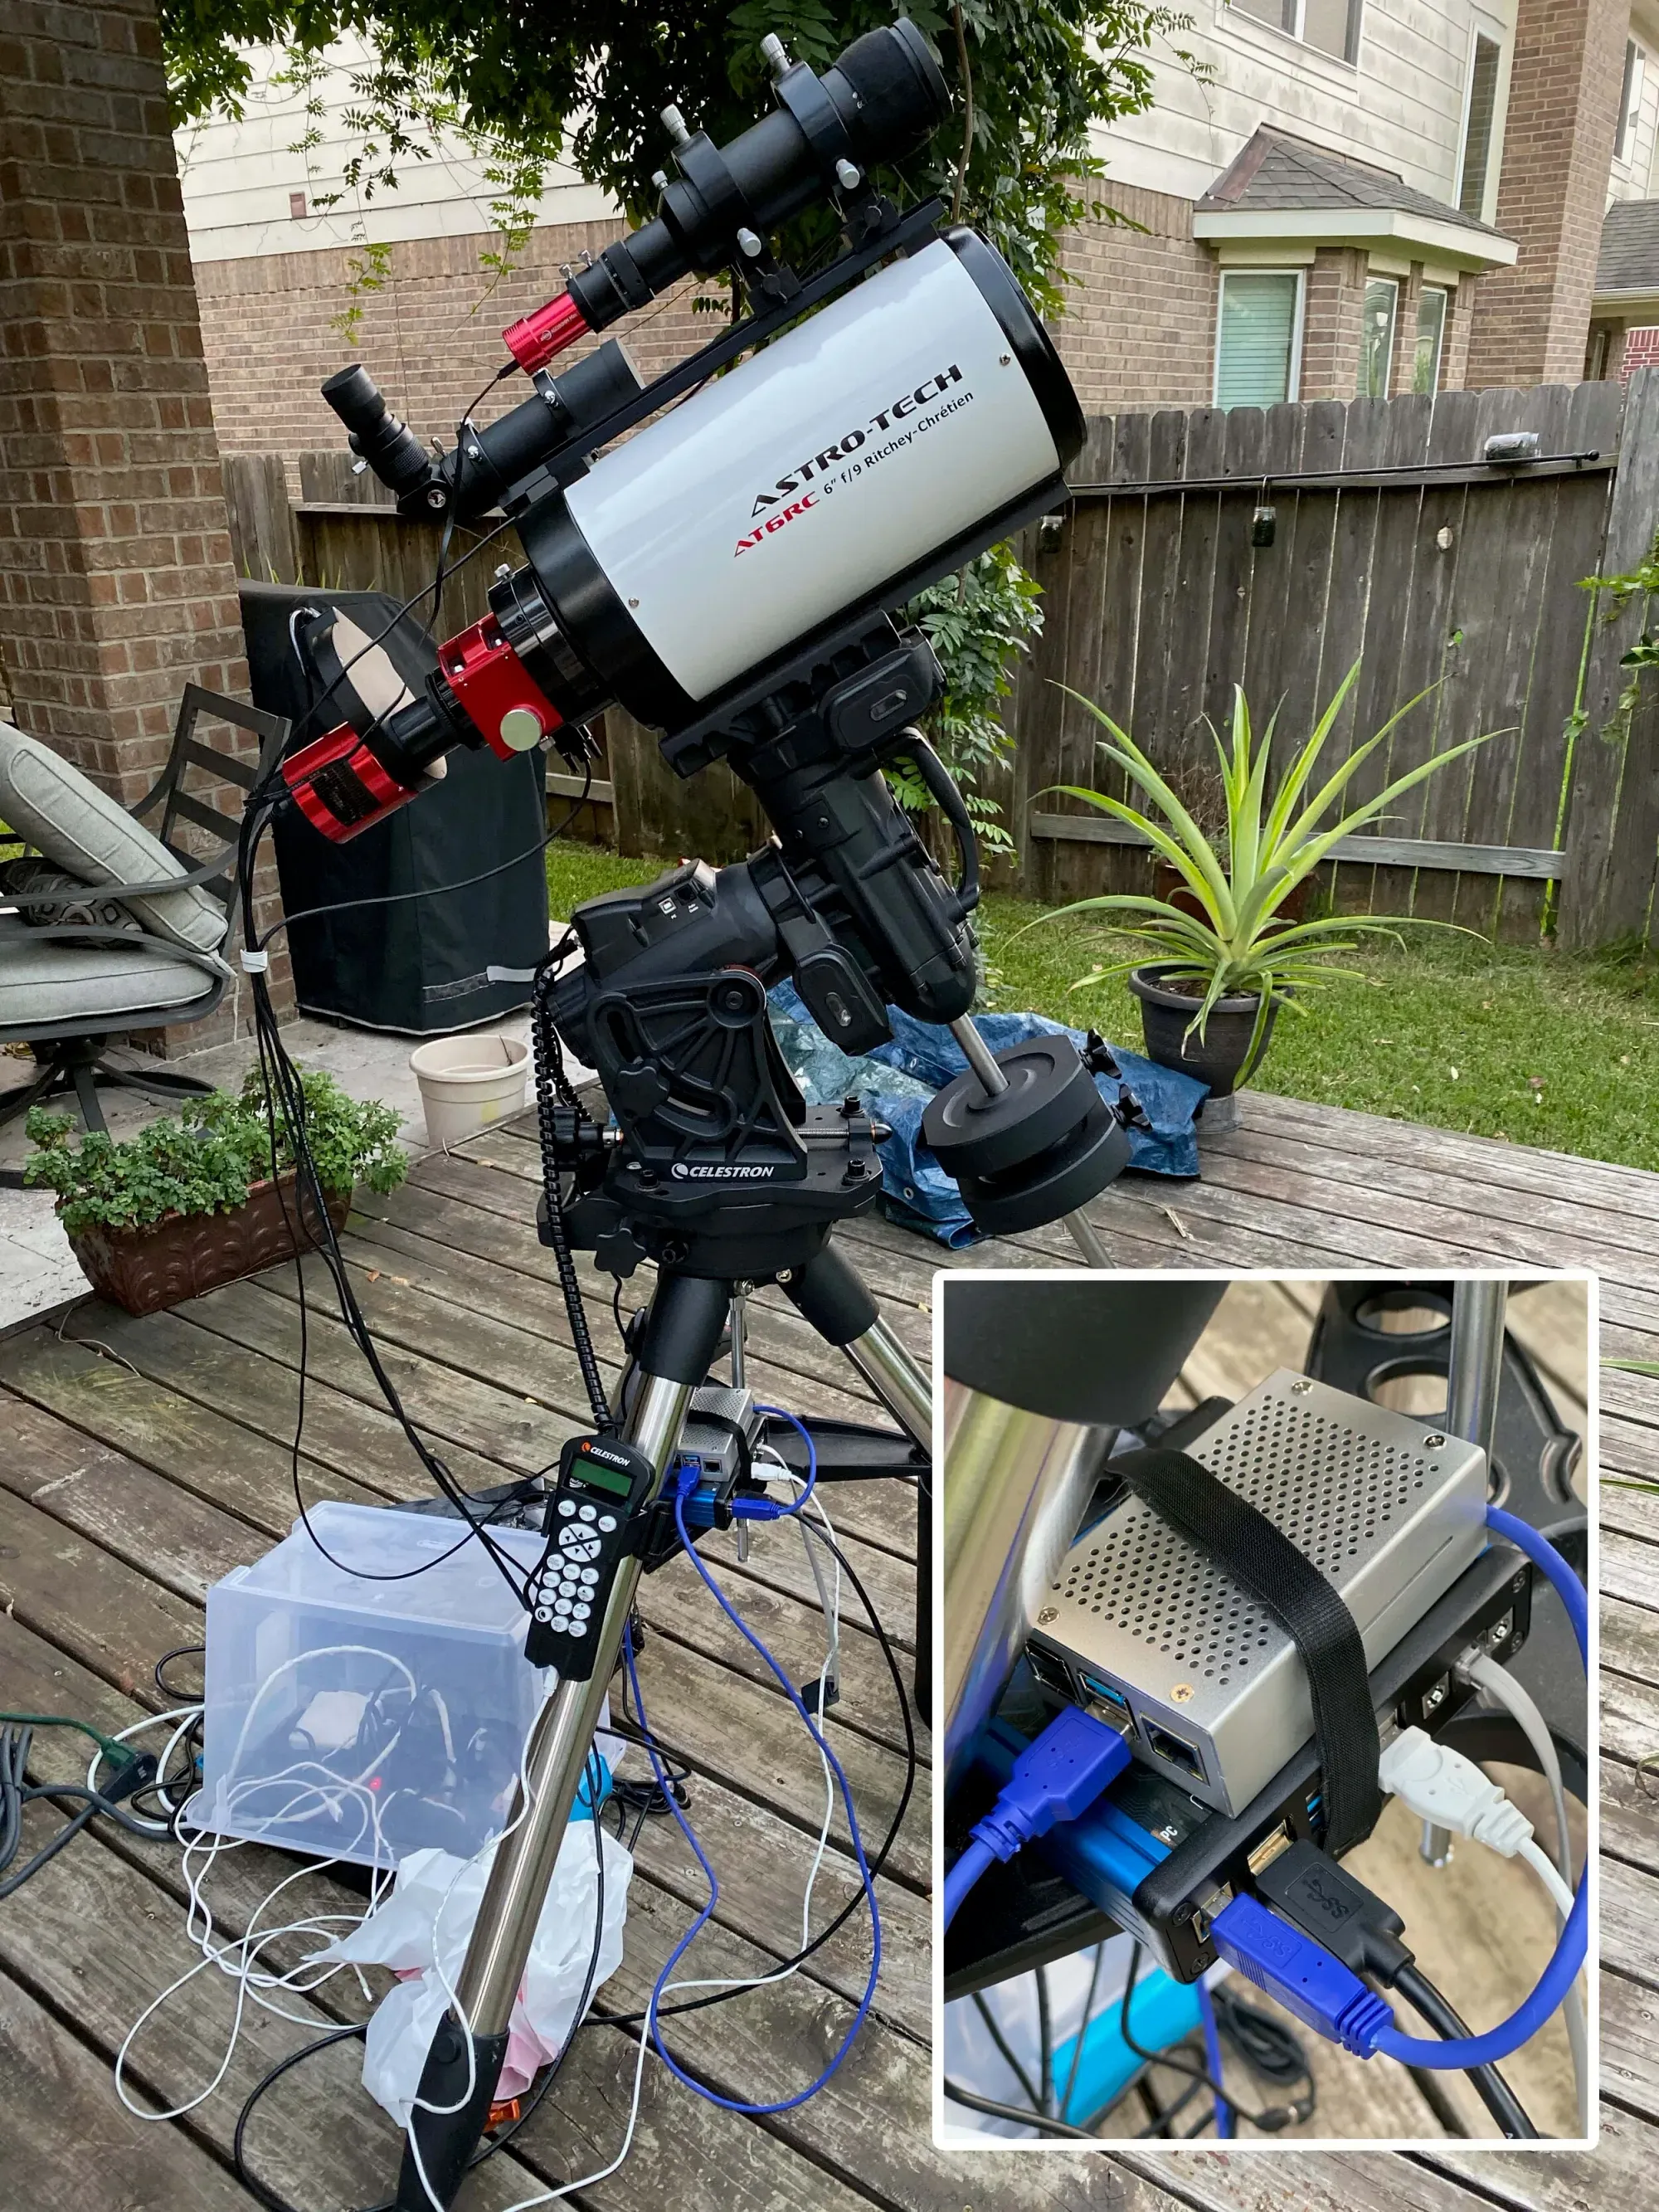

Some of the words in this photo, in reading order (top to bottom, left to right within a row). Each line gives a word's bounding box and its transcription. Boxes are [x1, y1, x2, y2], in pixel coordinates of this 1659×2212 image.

[752, 364, 963, 518] ASTRO-TECH
[734, 491, 820, 558] AT6RC
[841, 464, 862, 484] f/9
[864, 391, 974, 468] Ritchey-Chrétien
[689, 1167, 775, 1177] CELESTRON
[590, 1446, 630, 1467] CELESTRON
[1160, 1825, 1178, 1842] PC
